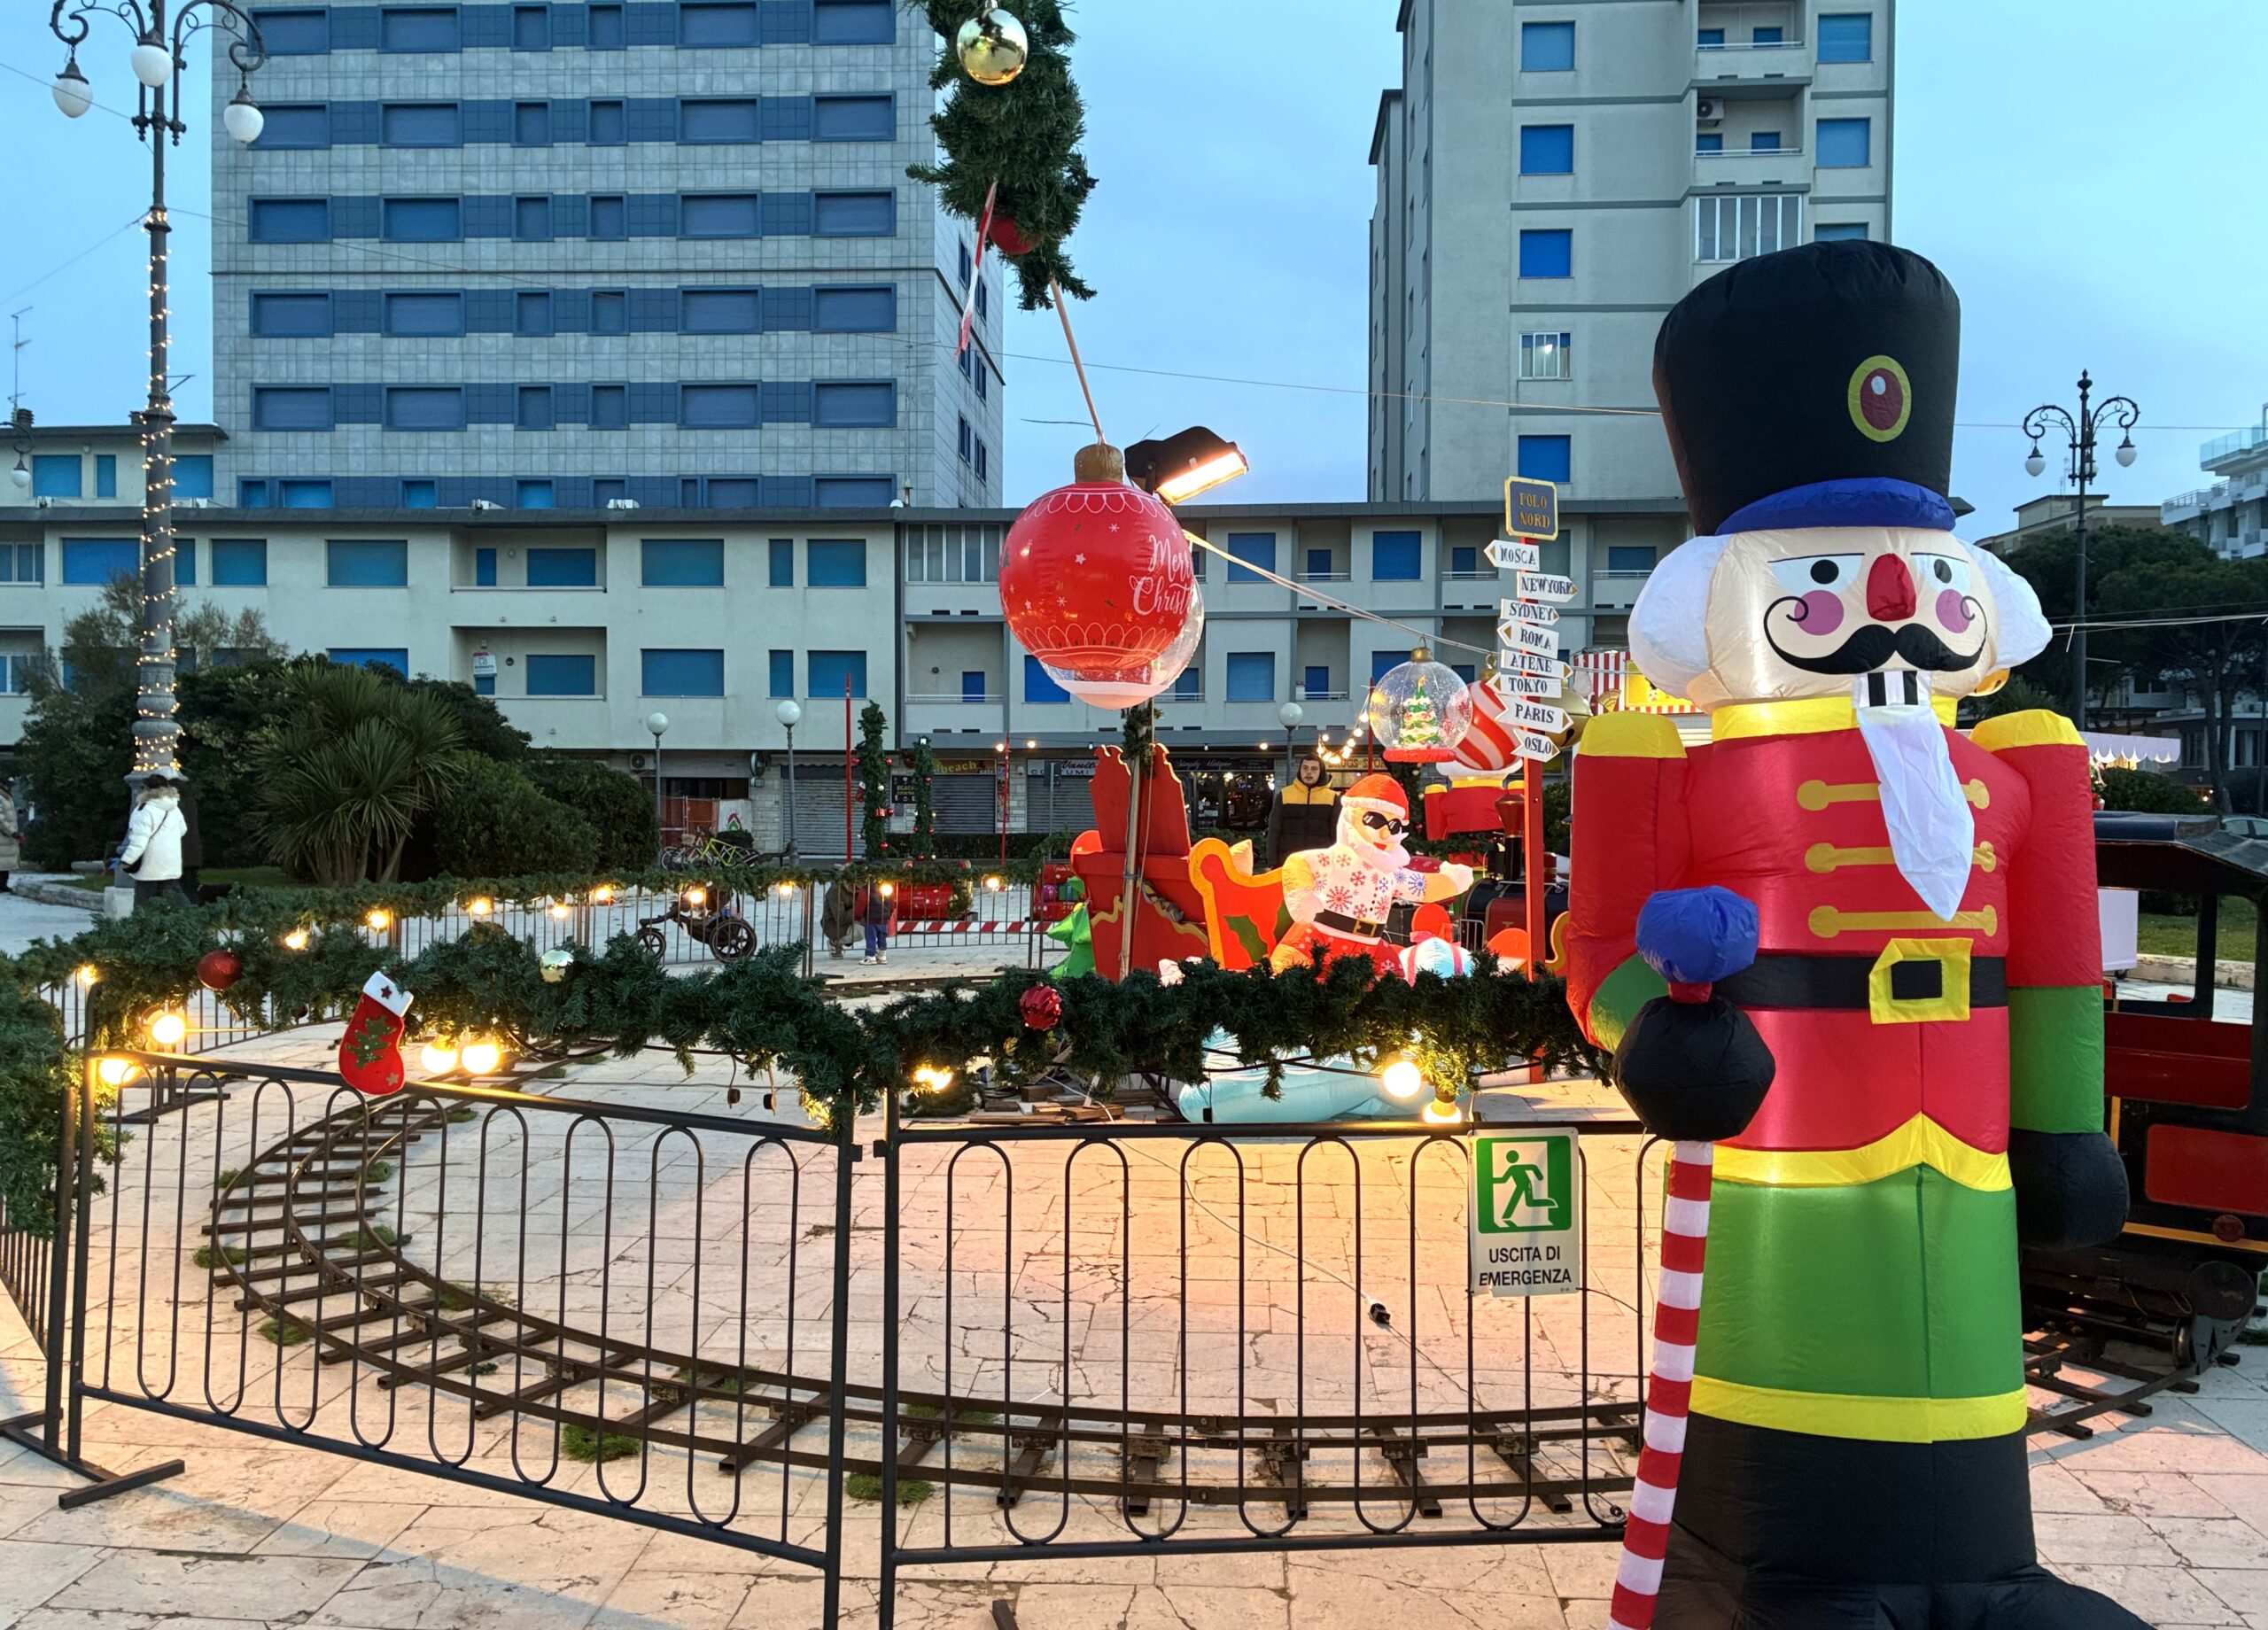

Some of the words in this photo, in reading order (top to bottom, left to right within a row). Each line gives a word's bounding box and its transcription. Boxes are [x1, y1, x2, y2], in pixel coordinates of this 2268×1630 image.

[1519, 493, 1547, 509] POLO
[1520, 511, 1550, 529] NORD
[1500, 545, 1536, 565] MOSCA
[1510, 602, 1553, 621] SYDNEY
[1520, 627, 1552, 651] ROMA
[1511, 653, 1552, 673] ATENE
[1508, 677, 1548, 694] TOKYO
[1515, 702, 1554, 724] PARIS
[1525, 736, 1551, 755] OSLO
[940, 761, 977, 774] beach
[1061, 760, 1096, 769] Vanit
[1488, 1246, 1542, 1263] USCITA
[1546, 1246, 1560, 1261] DI
[1479, 1268, 1572, 1287] EMERGENZA
